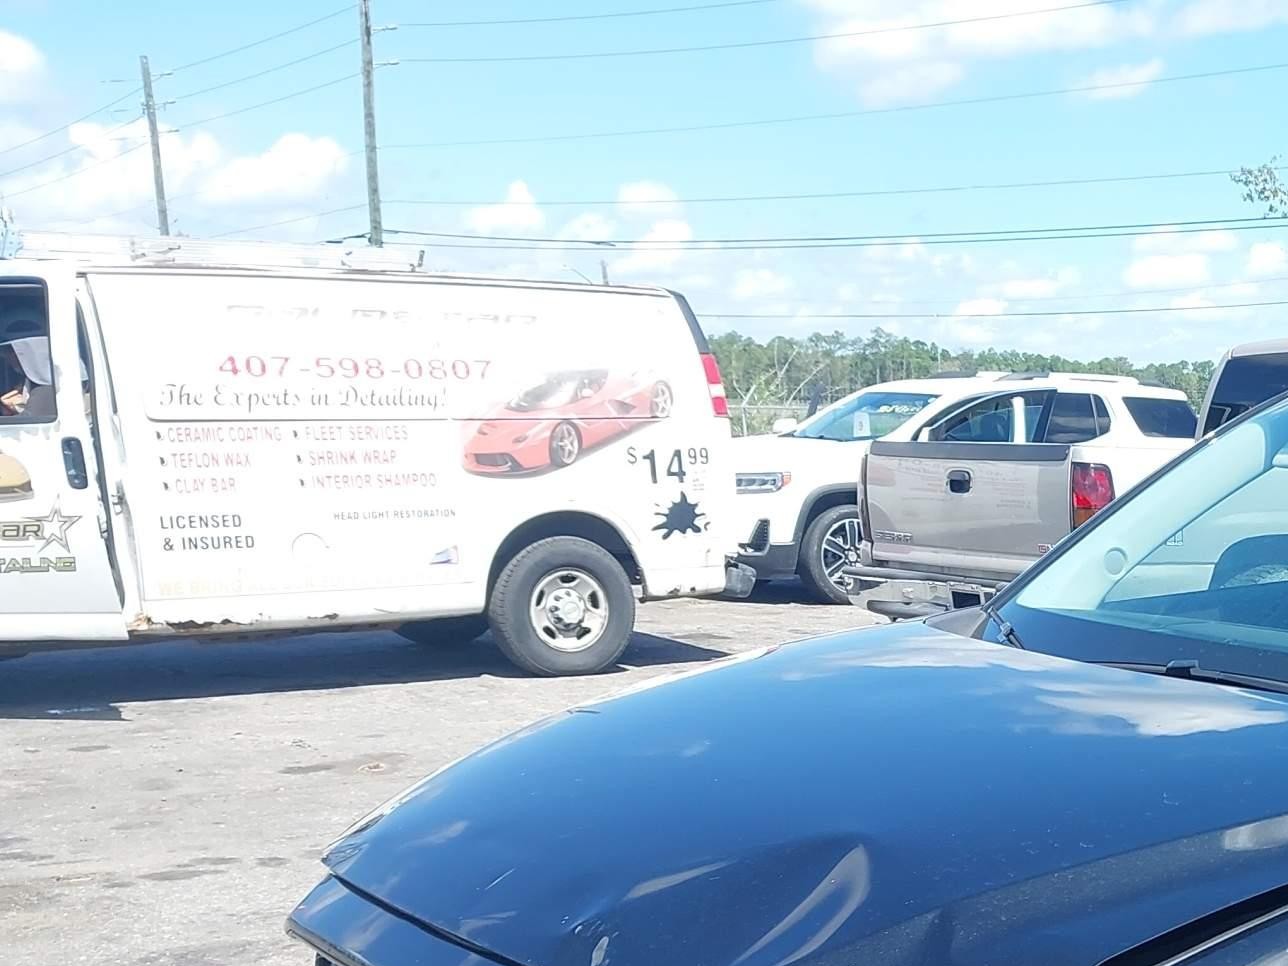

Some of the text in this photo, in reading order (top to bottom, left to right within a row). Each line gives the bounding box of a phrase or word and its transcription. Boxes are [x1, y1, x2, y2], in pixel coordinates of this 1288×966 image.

[218, 355, 492, 380] 407-598-0807
[159, 383, 447, 413] The Experts in Detailing!
[167, 426, 282, 443] CERAMIC COATING
[304, 425, 409, 441] FLEET SERVICES
[170, 452, 252, 469] TEFLON WAX
[308, 449, 398, 466] SHRINK WRAP
[175, 477, 237, 494] CLAY BAR
[311, 472, 438, 489] INTERIOR SHAMPOO
[159, 514, 242, 530] LICENSED
[333, 511, 359, 521] HEAD
[393, 508, 456, 520] RESTORATION
[163, 535, 255, 551] & INSURED
